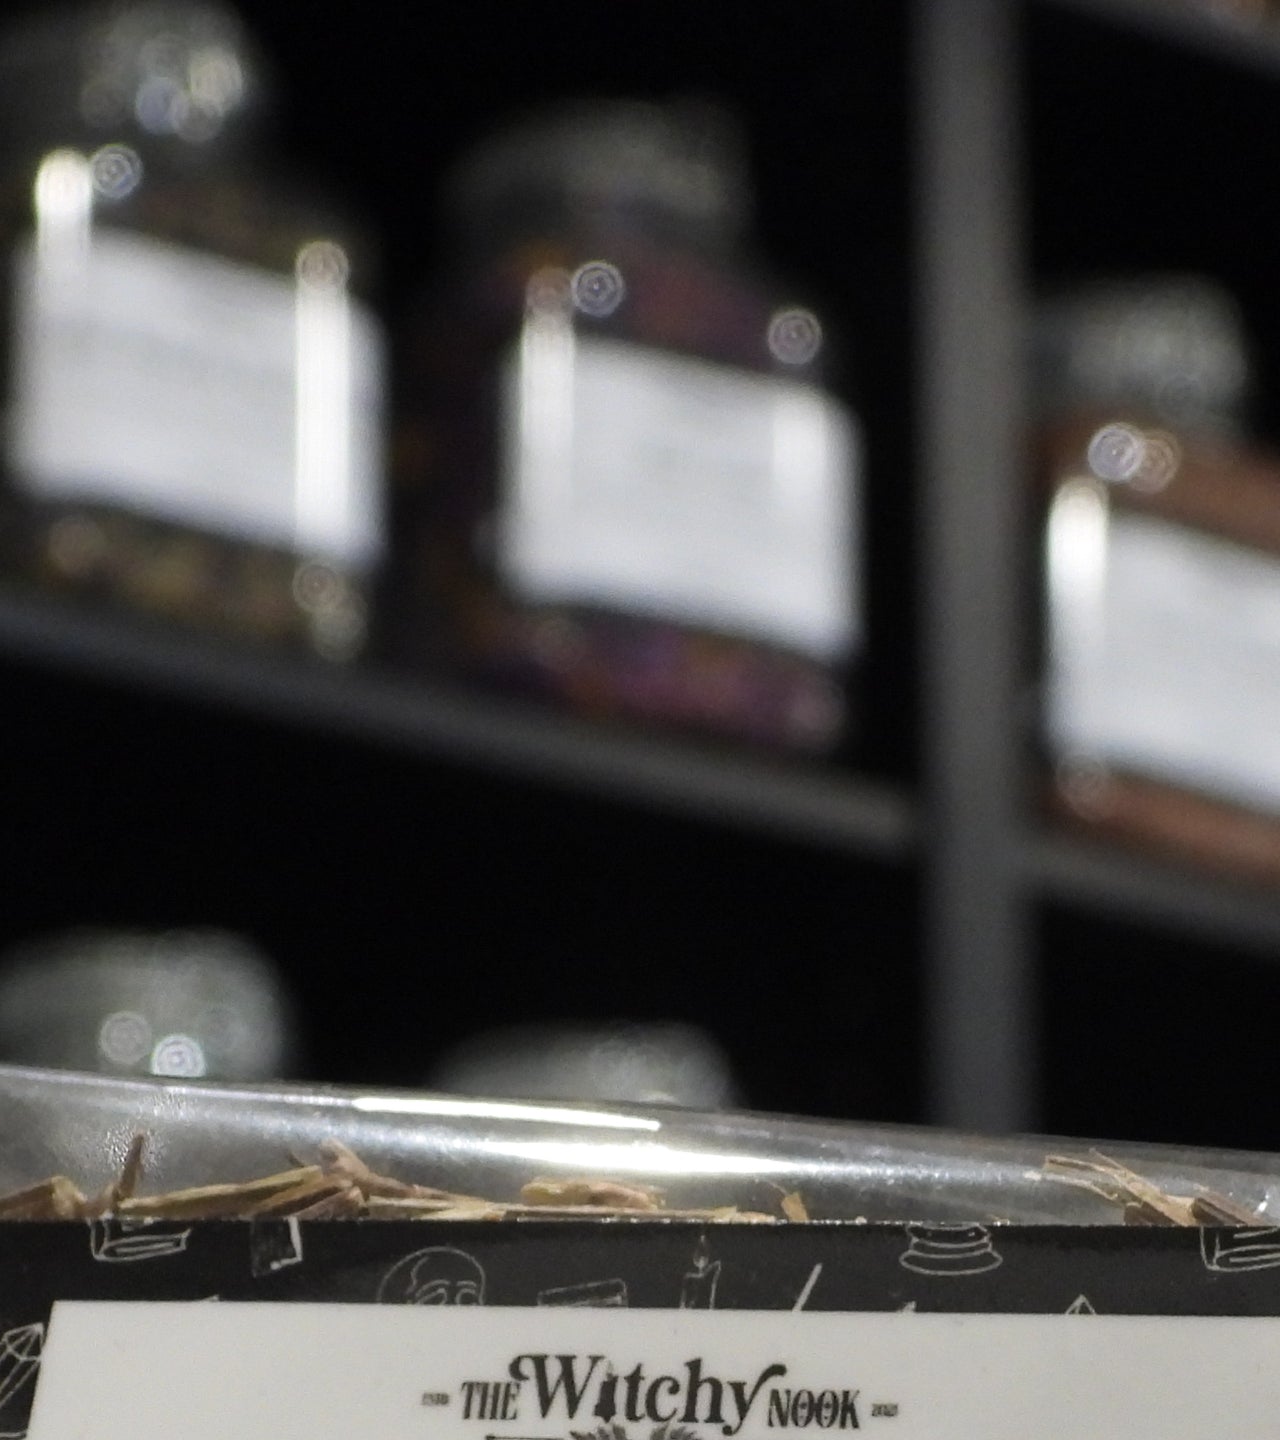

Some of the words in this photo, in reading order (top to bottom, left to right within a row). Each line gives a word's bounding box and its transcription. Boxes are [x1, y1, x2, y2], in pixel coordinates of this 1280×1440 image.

[460, 1380, 520, 1421] THE
[508, 1353, 788, 1436] Witchy
[766, 1387, 860, 1430] NOOK
